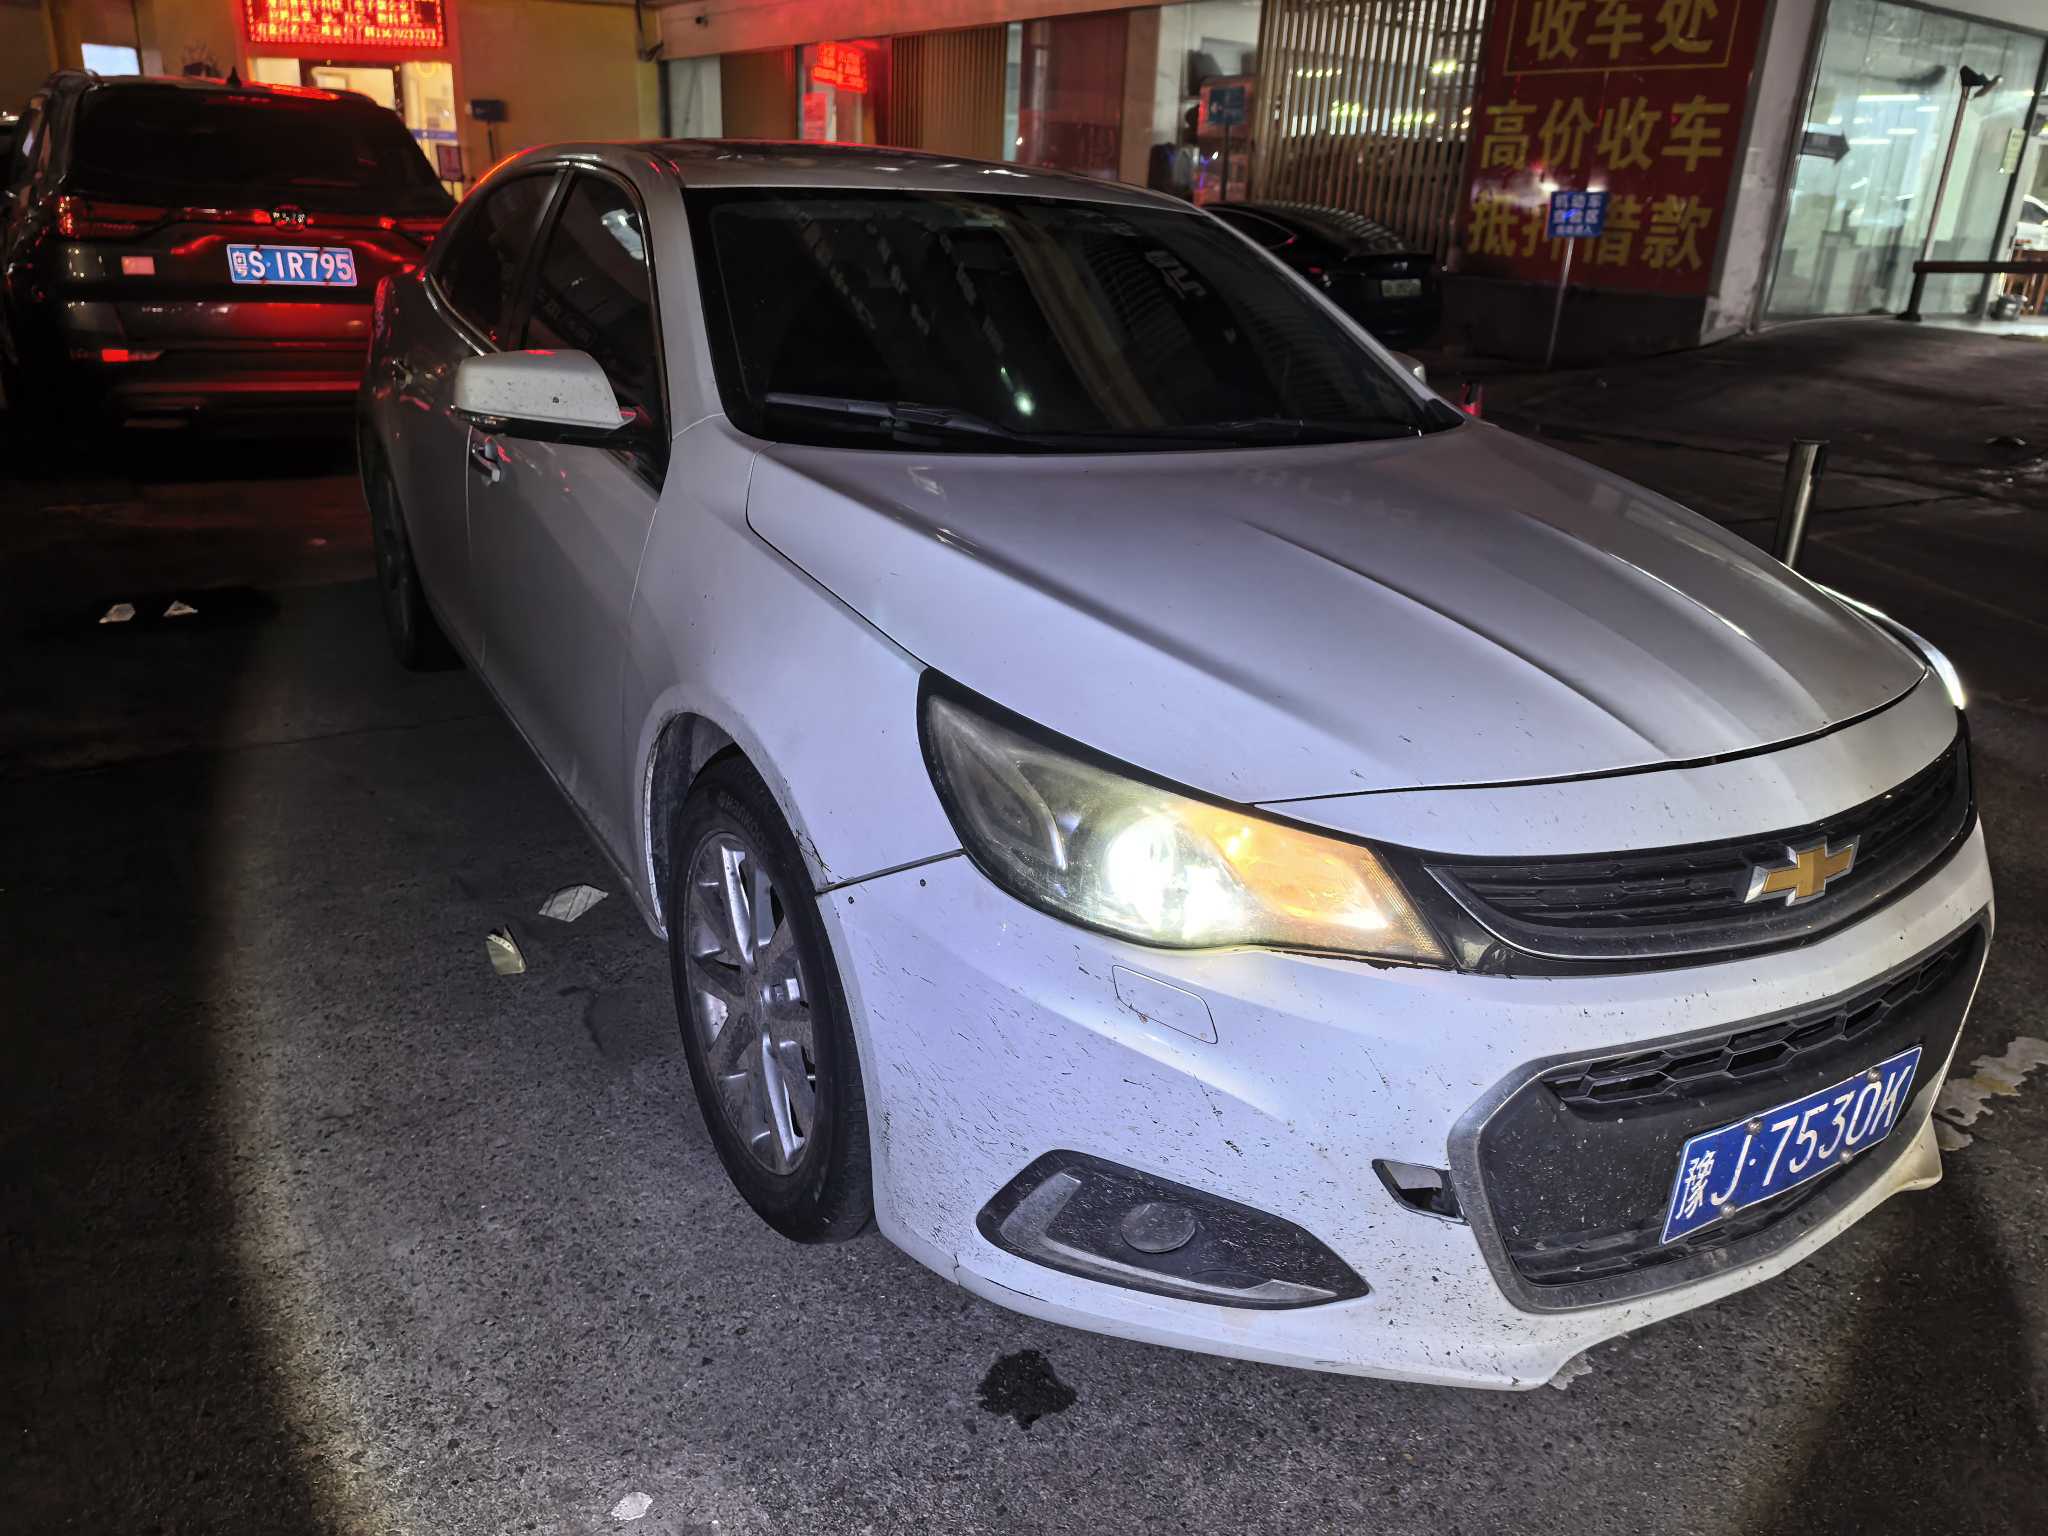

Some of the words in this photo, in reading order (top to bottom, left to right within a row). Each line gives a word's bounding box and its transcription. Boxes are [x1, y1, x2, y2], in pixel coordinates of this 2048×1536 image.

[1526, 0, 1719, 60] 收车处
[1480, 94, 1731, 172] 高价收车
[1675, 1064, 1912, 1219] 豫J·7530K
